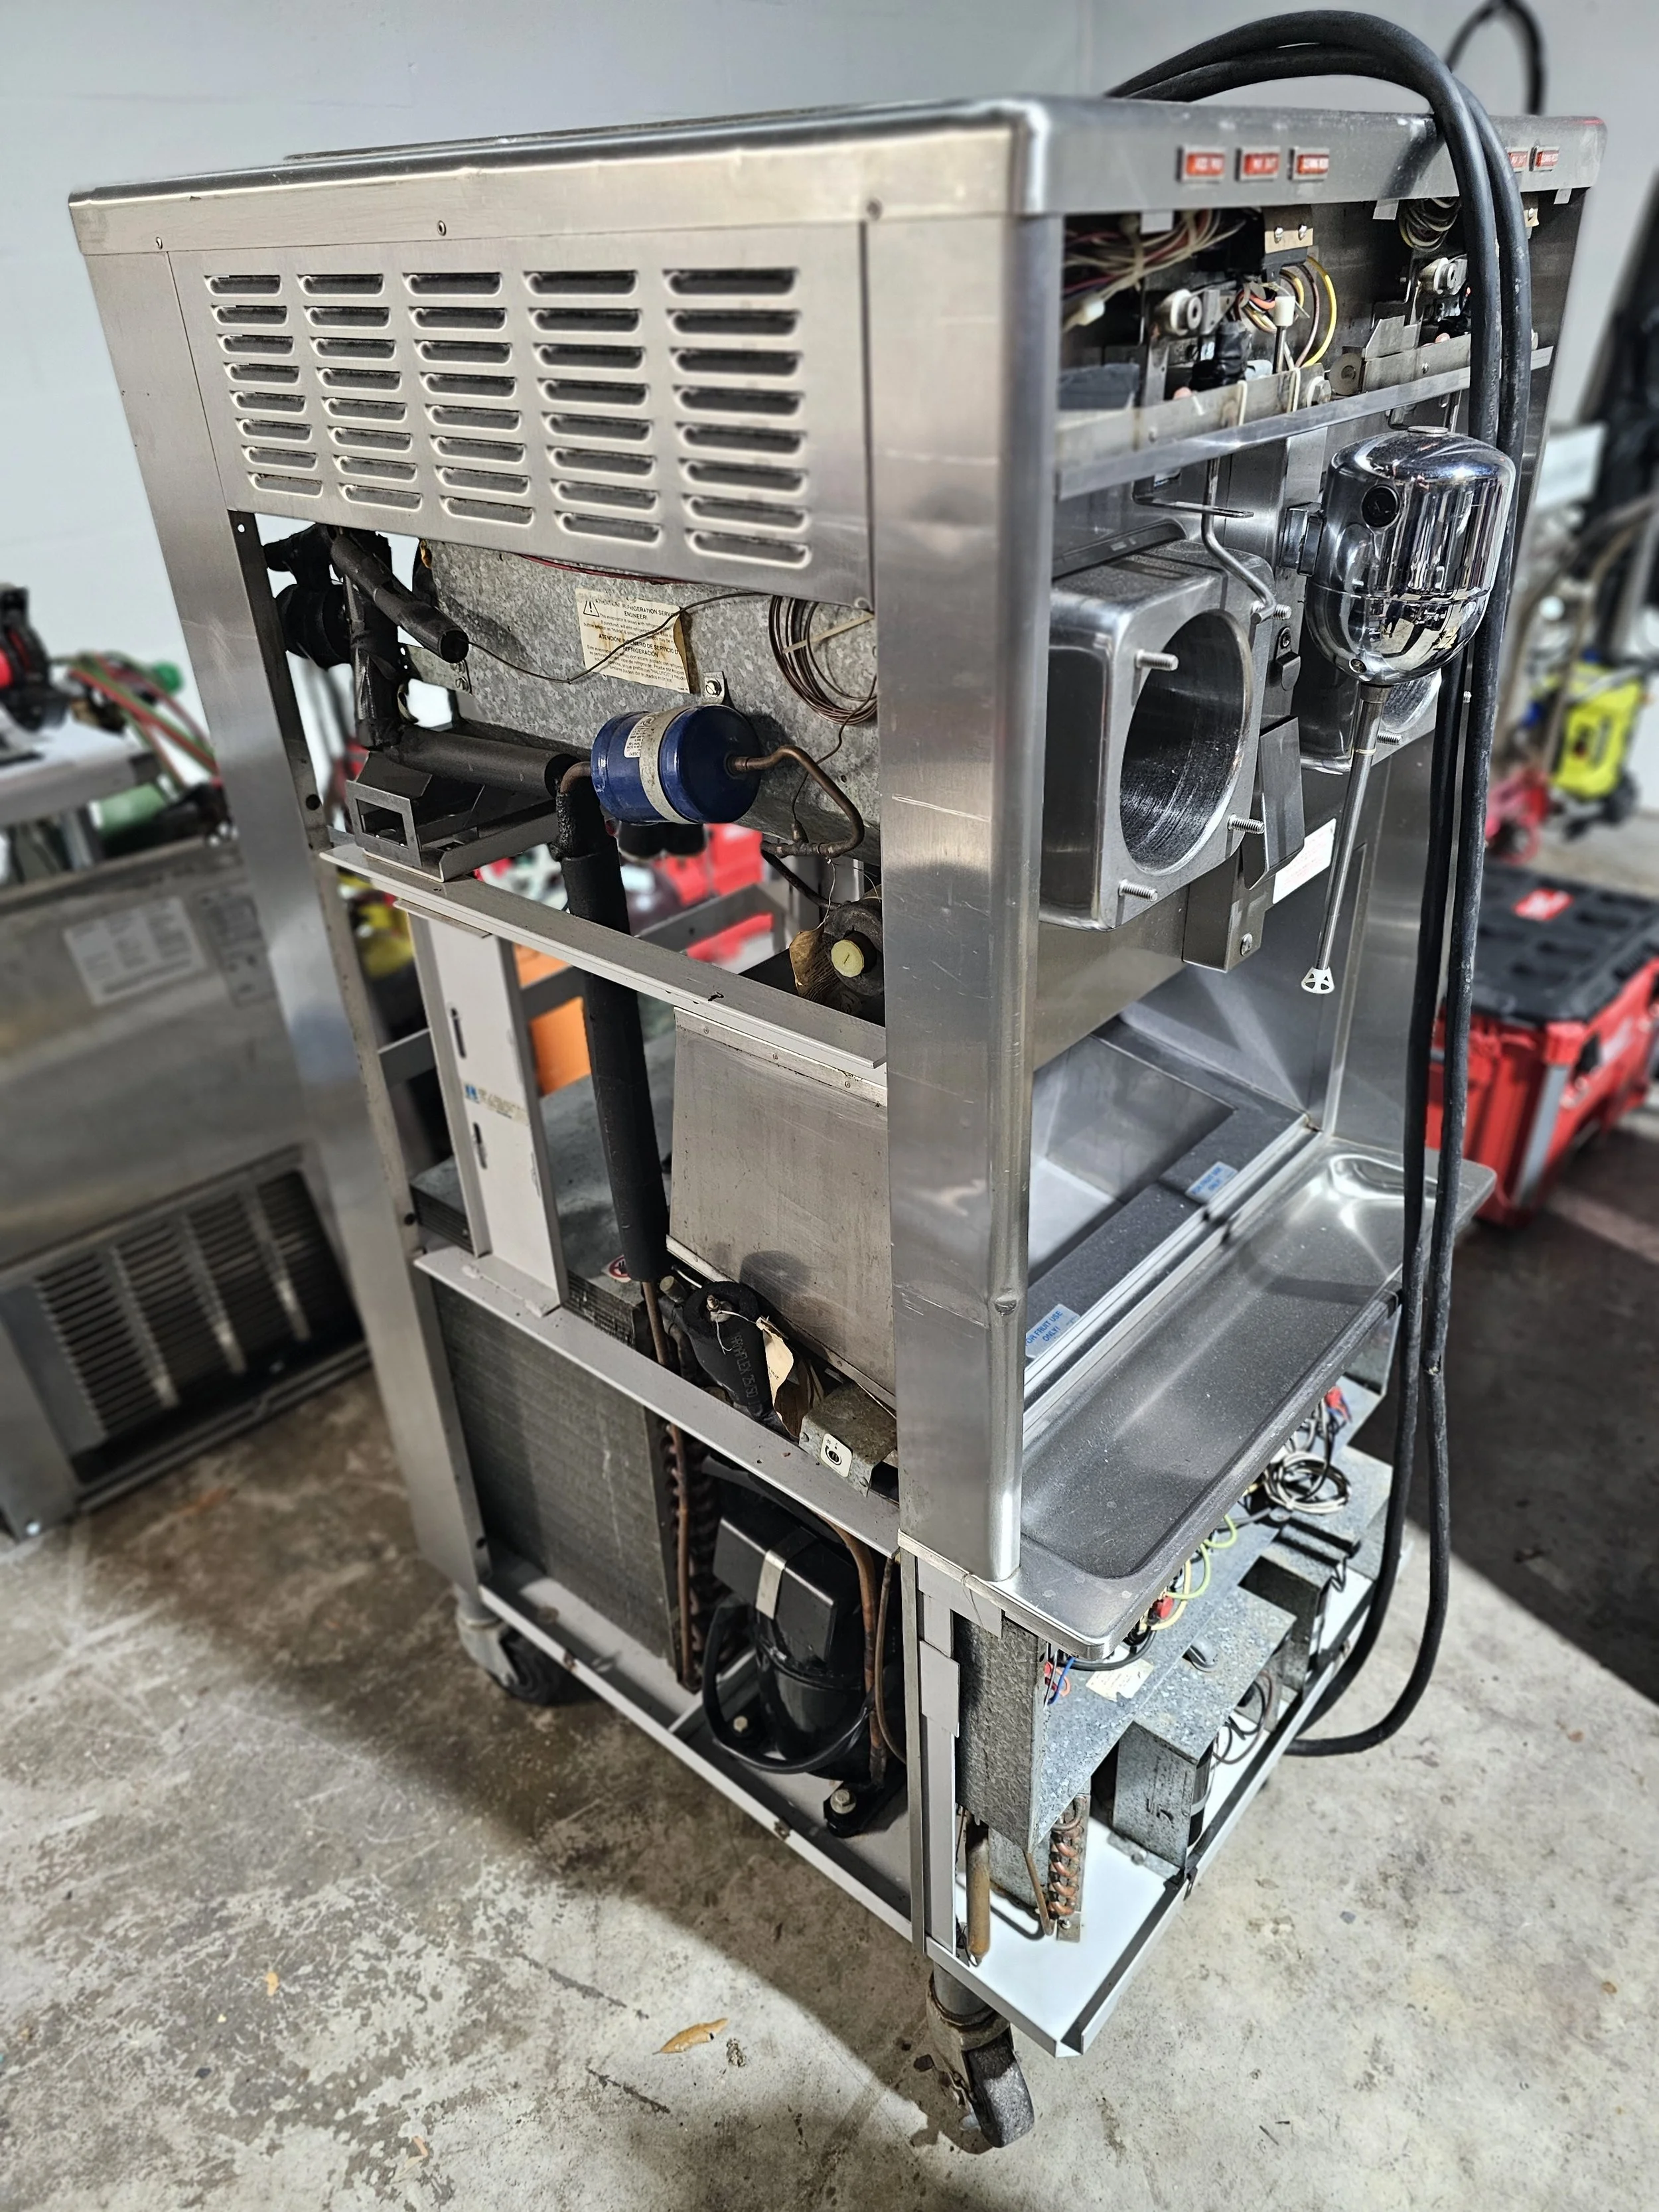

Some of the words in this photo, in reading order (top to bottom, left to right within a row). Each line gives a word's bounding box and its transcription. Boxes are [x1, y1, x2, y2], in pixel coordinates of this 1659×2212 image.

[654, 644, 674, 653] SERVICIO
[1034, 1320, 1052, 1337] FRUIT
[1049, 1311, 1063, 1322] USE
[1042, 1326, 1060, 1341] ONLY!
